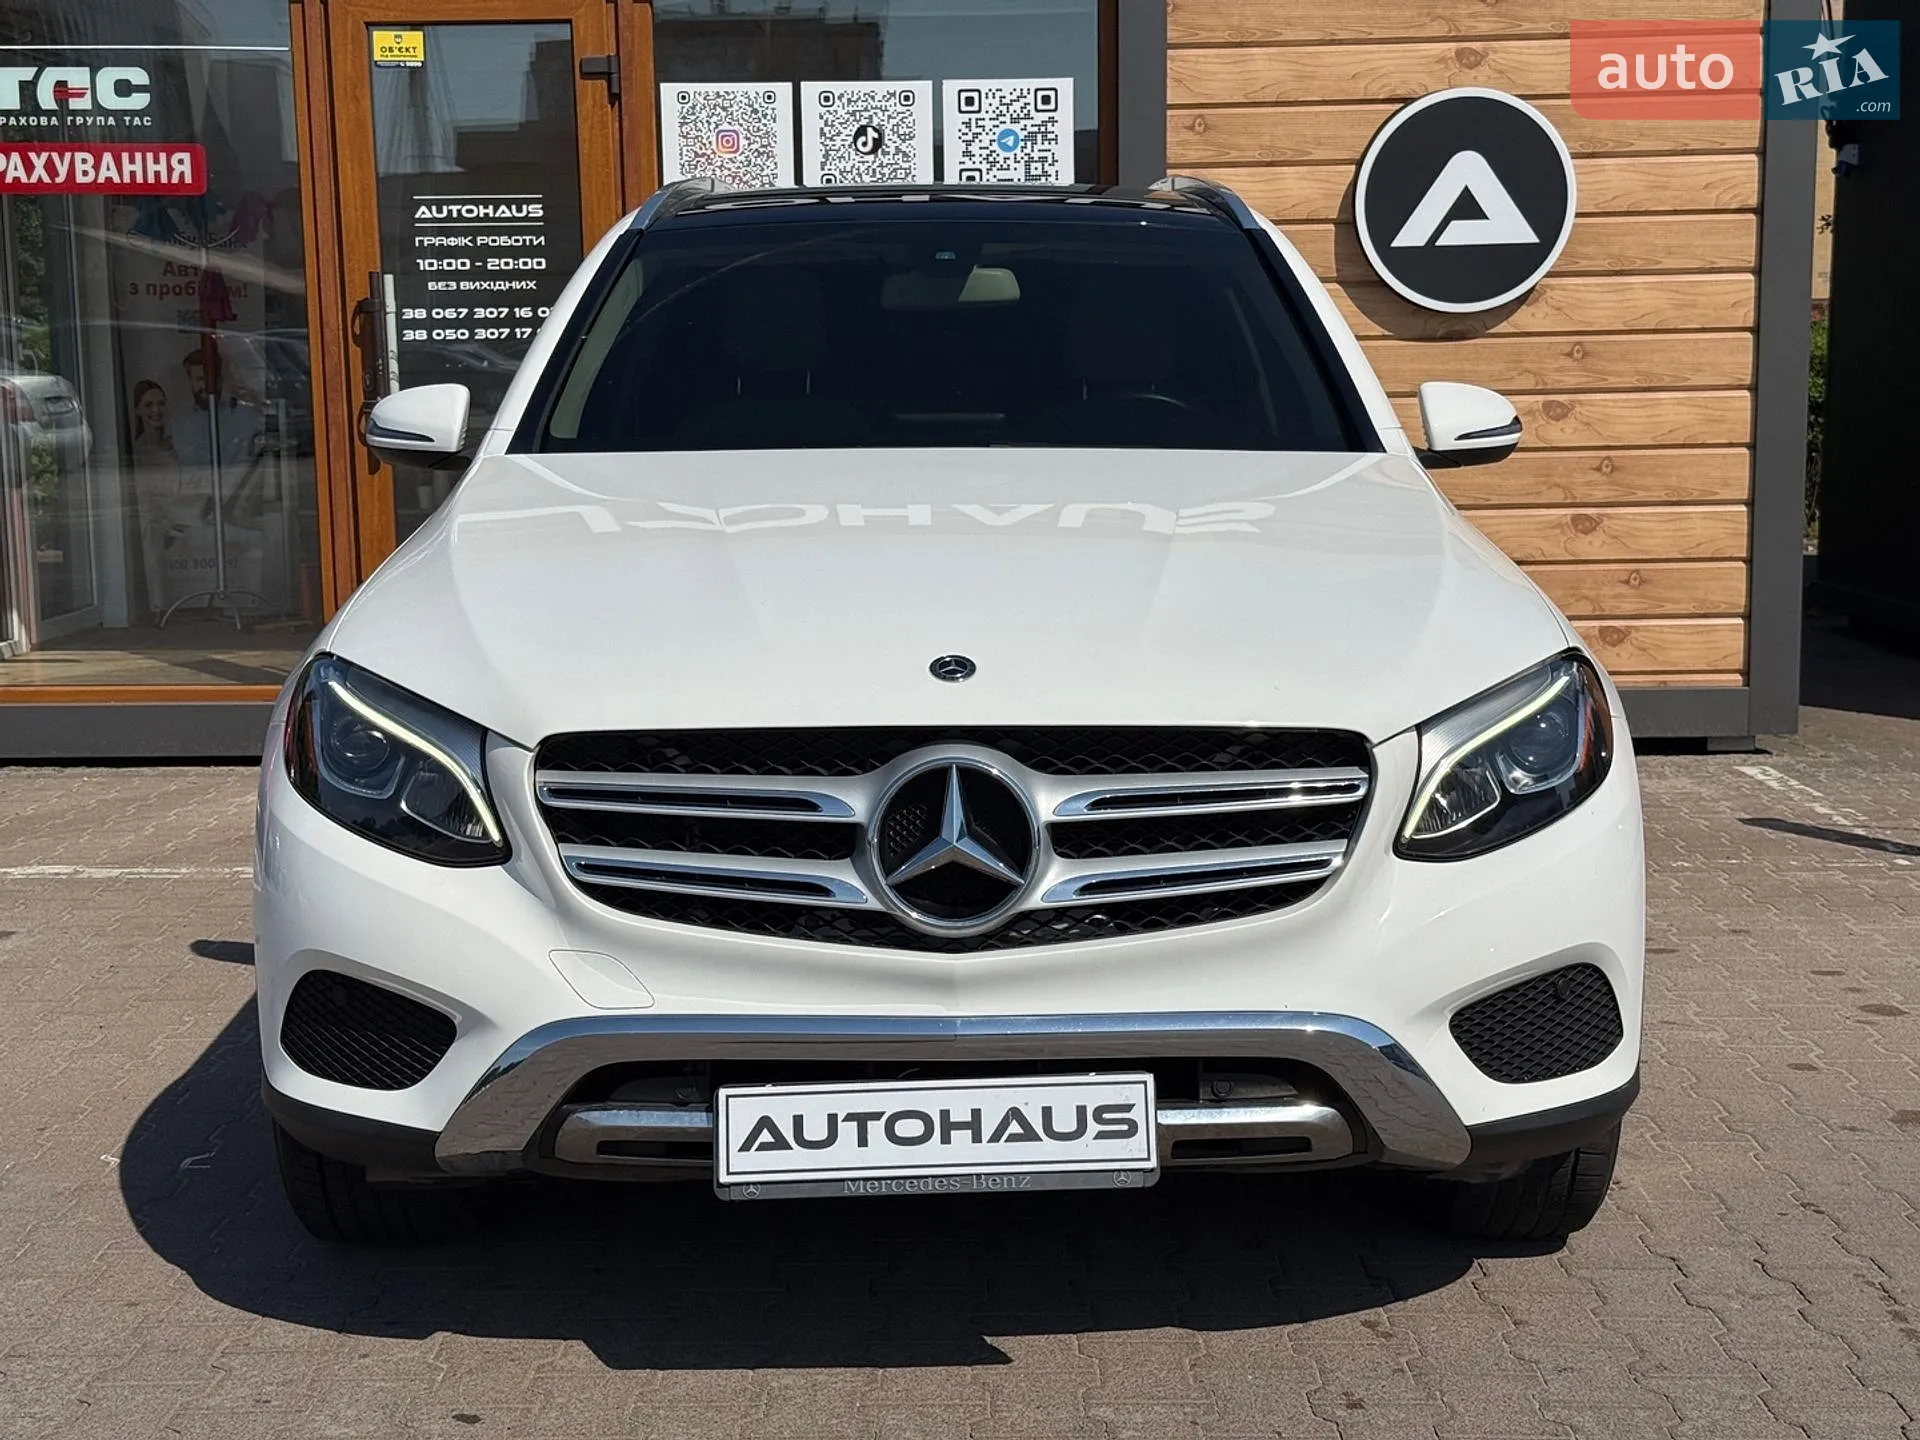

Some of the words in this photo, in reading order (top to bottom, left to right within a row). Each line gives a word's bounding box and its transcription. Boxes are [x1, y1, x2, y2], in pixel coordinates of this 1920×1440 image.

[67, 116, 116, 127] ГРУПА
[123, 116, 152, 126] ТАС
[414, 204, 544, 219] AUTOHAUS
[414, 236, 474, 247] ГРАФІК
[476, 235, 546, 246] РОБОТИ
[162, 260, 202, 278] Авт
[416, 258, 471, 271] 10:00
[486, 257, 547, 270] 20:00
[427, 281, 458, 291] БЕЗ
[460, 280, 537, 291] ВИХІДНИХ
[401, 307, 427, 319] 38
[431, 307, 469, 319] 067
[473, 306, 510, 319] 307
[513, 306, 534, 318] 16
[537, 306, 554, 318] 0
[402, 329, 428, 341] 38
[432, 328, 470, 341] 050
[474, 328, 511, 340] 307
[514, 327, 533, 339] 17
[736, 1102, 1140, 1152] AUTOHAUS
